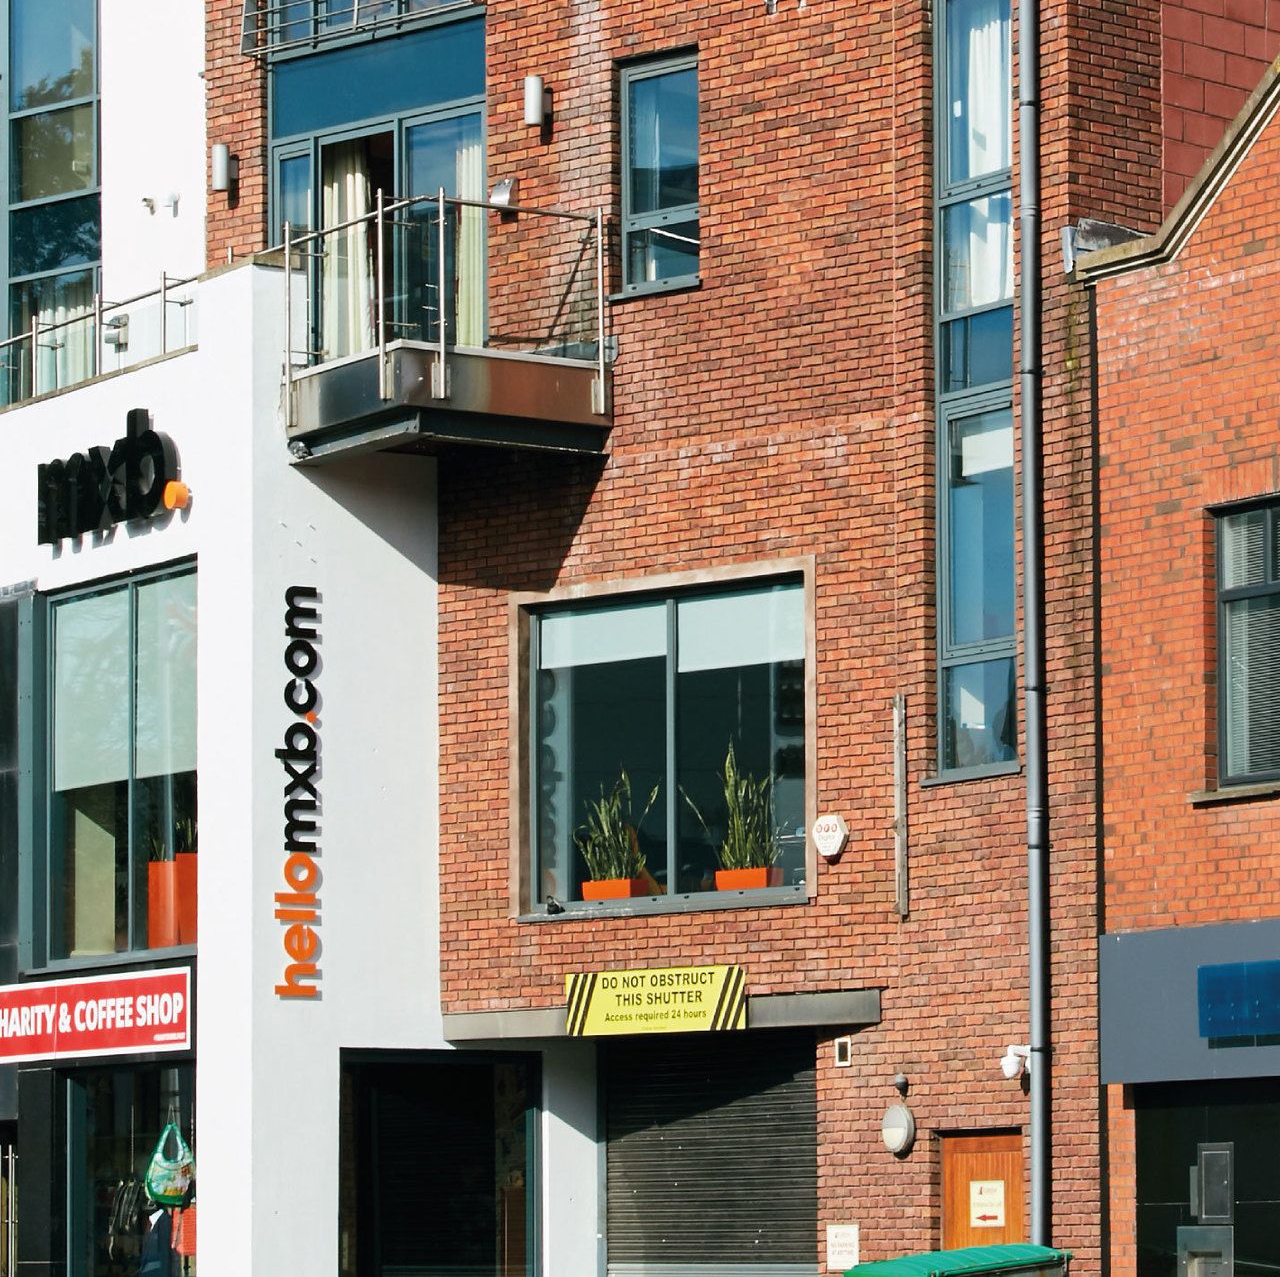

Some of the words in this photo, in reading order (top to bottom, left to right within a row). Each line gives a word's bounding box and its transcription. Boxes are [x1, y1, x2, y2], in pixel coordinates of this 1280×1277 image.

[275, 585, 318, 999] hellomxb.com
[602, 977, 618, 989] DO
[622, 975, 647, 988] NOT
[650, 972, 715, 987] OBSTRUCT
[616, 992, 642, 1006] THIS
[646, 990, 702, 1004] SHUTTER
[58, 1002, 72, 1034] &
[74, 995, 133, 1033] COFFEE
[135, 992, 184, 1025] SHOP
[605, 1012, 632, 1022] Access
[635, 1010, 669, 1021] required
[671, 1010, 681, 1019] 24
[683, 1009, 707, 1019] hours
